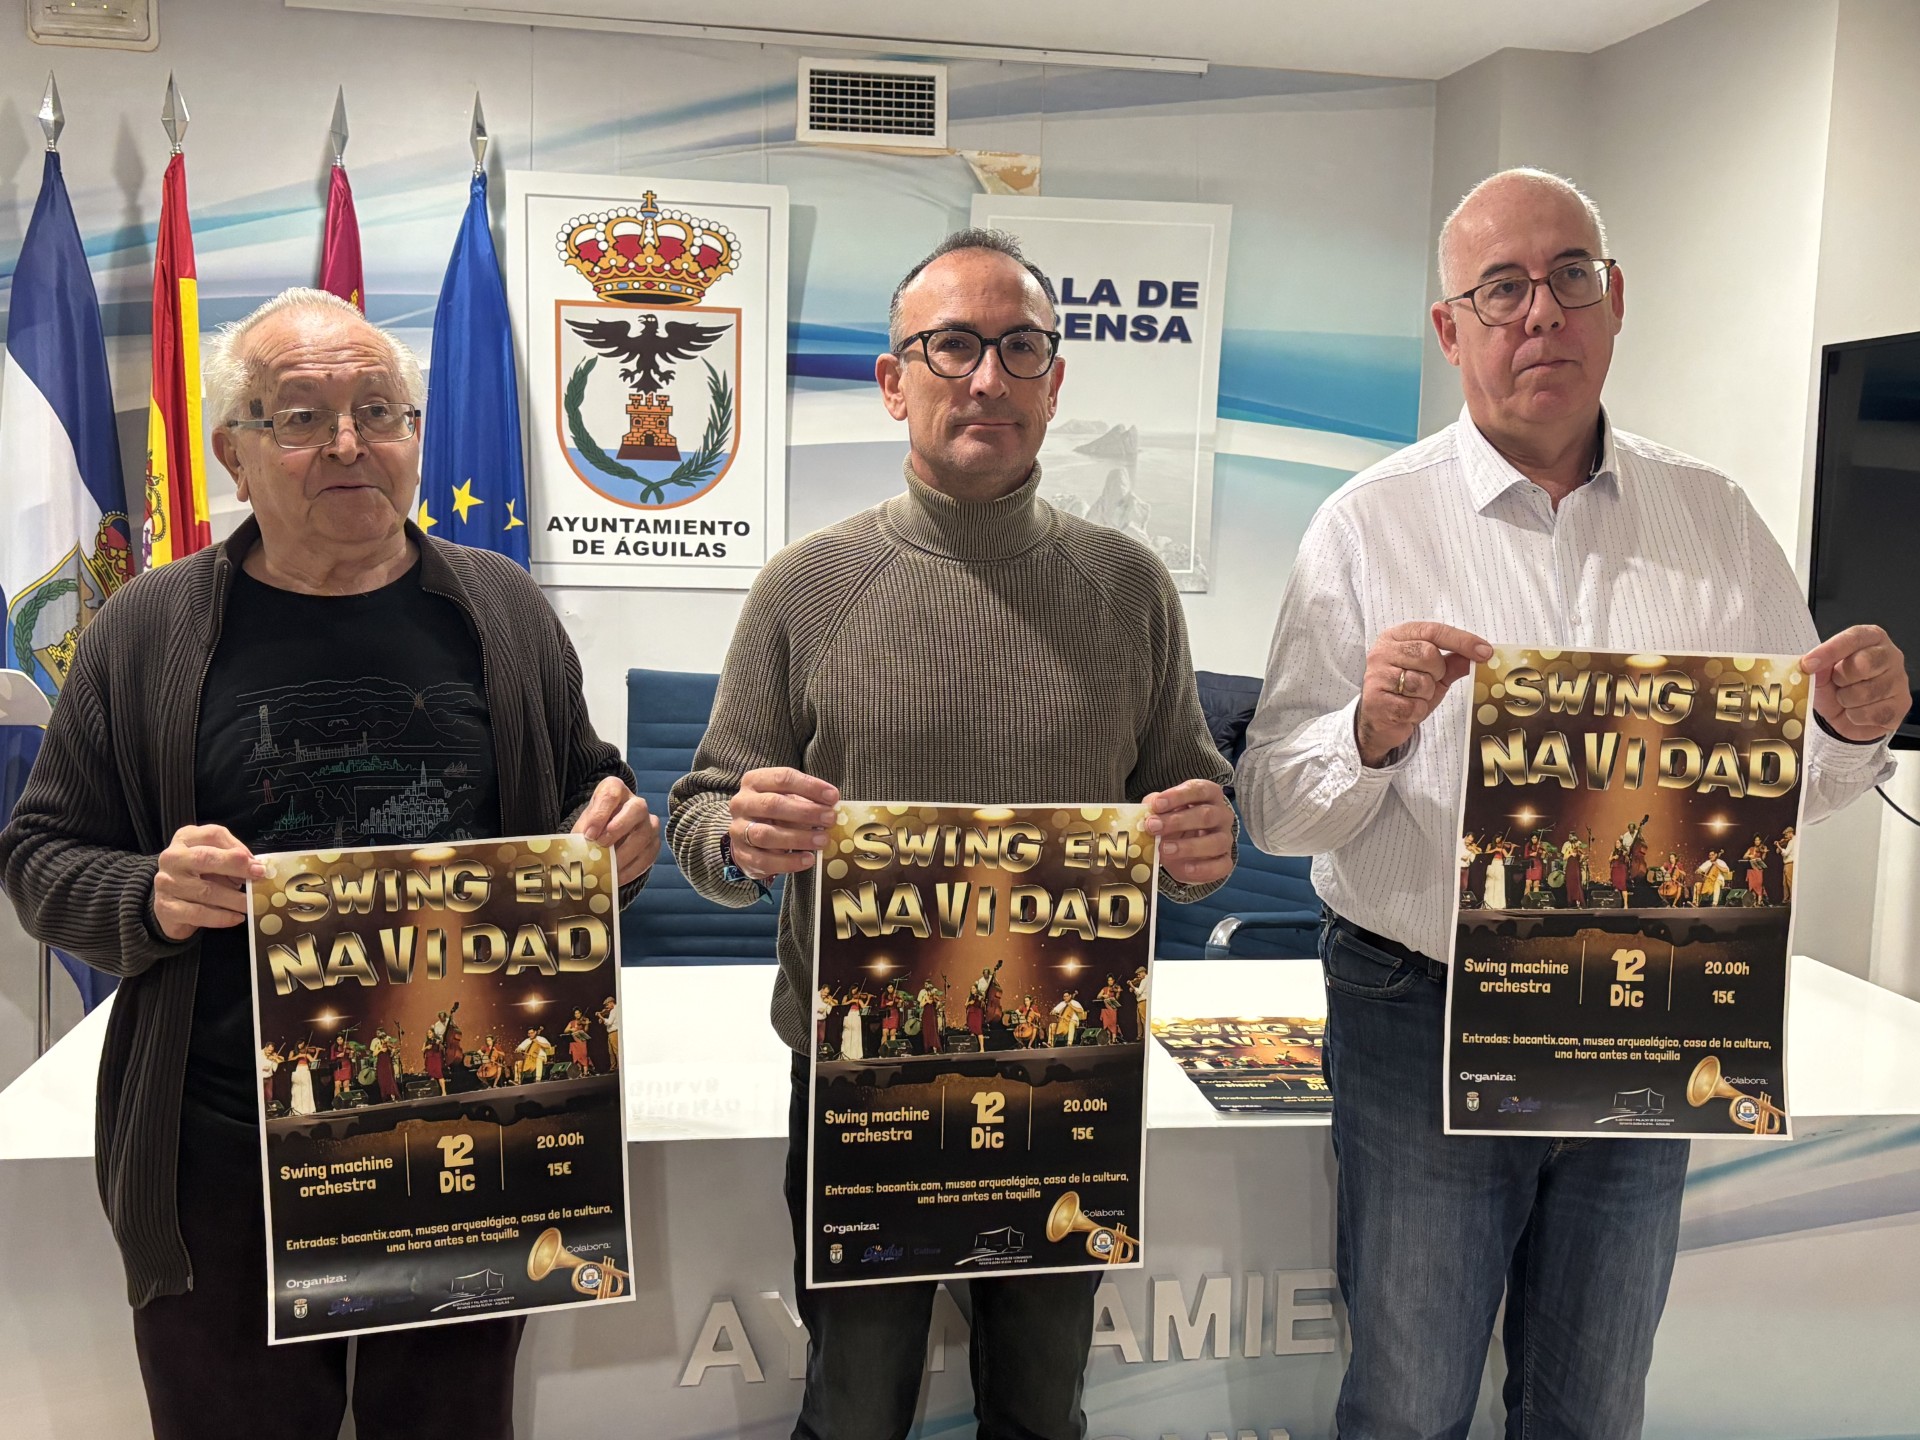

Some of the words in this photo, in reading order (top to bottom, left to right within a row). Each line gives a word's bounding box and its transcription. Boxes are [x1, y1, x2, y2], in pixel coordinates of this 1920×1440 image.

[1045, 277, 1122, 307] LA
[1137, 280, 1199, 308] DE
[1056, 313, 1192, 344] ENSA
[547, 516, 750, 537] AYUNTAMIENTO
[572, 539, 605, 555] DE
[614, 537, 727, 558] ÁGUILAS
[1504, 666, 1696, 725] SWING
[1716, 682, 1782, 724] EN
[1480, 728, 1800, 798] NAVIDAD
[853, 821, 1046, 873] SWING
[1064, 830, 1130, 869] EN
[284, 859, 491, 922] SWING
[515, 860, 584, 903] EN
[831, 880, 1148, 941] NAVIDAD
[267, 914, 611, 996] NAVIDAD
[1611, 948, 1646, 982] 12
[1464, 958, 1506, 976] Swing
[1511, 959, 1568, 974] machine
[1705, 961, 1750, 976] 20.00h
[1480, 978, 1551, 993] orchestra
[1610, 984, 1644, 1008] Dic
[1712, 990, 1735, 1004] 15€
[1167, 1023, 1291, 1035] SWING
[1303, 1025, 1324, 1034] E
[1165, 1037, 1323, 1048] NAVID
[1462, 1033, 1511, 1044] Entradas:
[1513, 1034, 1580, 1047] bacantix.com,
[1583, 1037, 1615, 1046] museo
[1617, 1036, 1681, 1049] arqueológico,
[1683, 1038, 1706, 1048] casa
[1709, 1038, 1720, 1048] de
[1722, 1038, 1732, 1048] la
[1734, 1038, 1771, 1050] cultura,
[1555, 1051, 1572, 1059] una
[1575, 1049, 1597, 1059] hora
[1599, 1050, 1628, 1060] antes
[1630, 1051, 1642, 1060] en
[1644, 1050, 1680, 1061] taquilla
[1460, 1072, 1516, 1082] Organiza:
[971, 1091, 1005, 1124] 12
[1063, 1098, 1107, 1112] 20.00h
[825, 1109, 868, 1126] Swing
[871, 1107, 930, 1122] machine
[537, 1132, 584, 1150] 20.00h
[841, 1128, 912, 1143] orchestra
[971, 1126, 1004, 1149] Dic
[1071, 1127, 1094, 1140] 15€
[437, 1134, 474, 1168] 12
[280, 1164, 326, 1181] Swing
[331, 1156, 393, 1173] machine
[548, 1161, 572, 1176] 15€
[300, 1176, 376, 1197] orchestra
[439, 1169, 476, 1194] Dic
[825, 1183, 874, 1196] Entradas:
[876, 1180, 943, 1194] bacantix.com,
[945, 1178, 977, 1189] museo
[979, 1175, 1041, 1190] arqueológico,
[1043, 1175, 1066, 1185] casa
[1069, 1173, 1080, 1183] de
[1082, 1172, 1090, 1182] la
[1092, 1172, 1129, 1183] cultura,
[918, 1194, 935, 1204] una
[937, 1191, 959, 1202] hora
[961, 1190, 989, 1201] antes
[991, 1190, 1003, 1199] en
[1005, 1188, 1041, 1201] taquilla
[286, 1234, 338, 1251] Entradas:
[341, 1227, 413, 1246] bacantix.com,
[415, 1222, 449, 1236] museo
[451, 1214, 519, 1233] arqueológico,
[521, 1212, 545, 1223] casa
[548, 1210, 561, 1221] de
[562, 1208, 571, 1218] la
[573, 1204, 613, 1218] cultura,
[823, 1221, 880, 1234] Organiza:
[387, 1241, 405, 1253] una
[408, 1238, 432, 1251] hora
[434, 1234, 464, 1248] antes
[466, 1233, 479, 1244] en
[481, 1228, 519, 1244] taquilla
[286, 1274, 347, 1289] Organiza:
